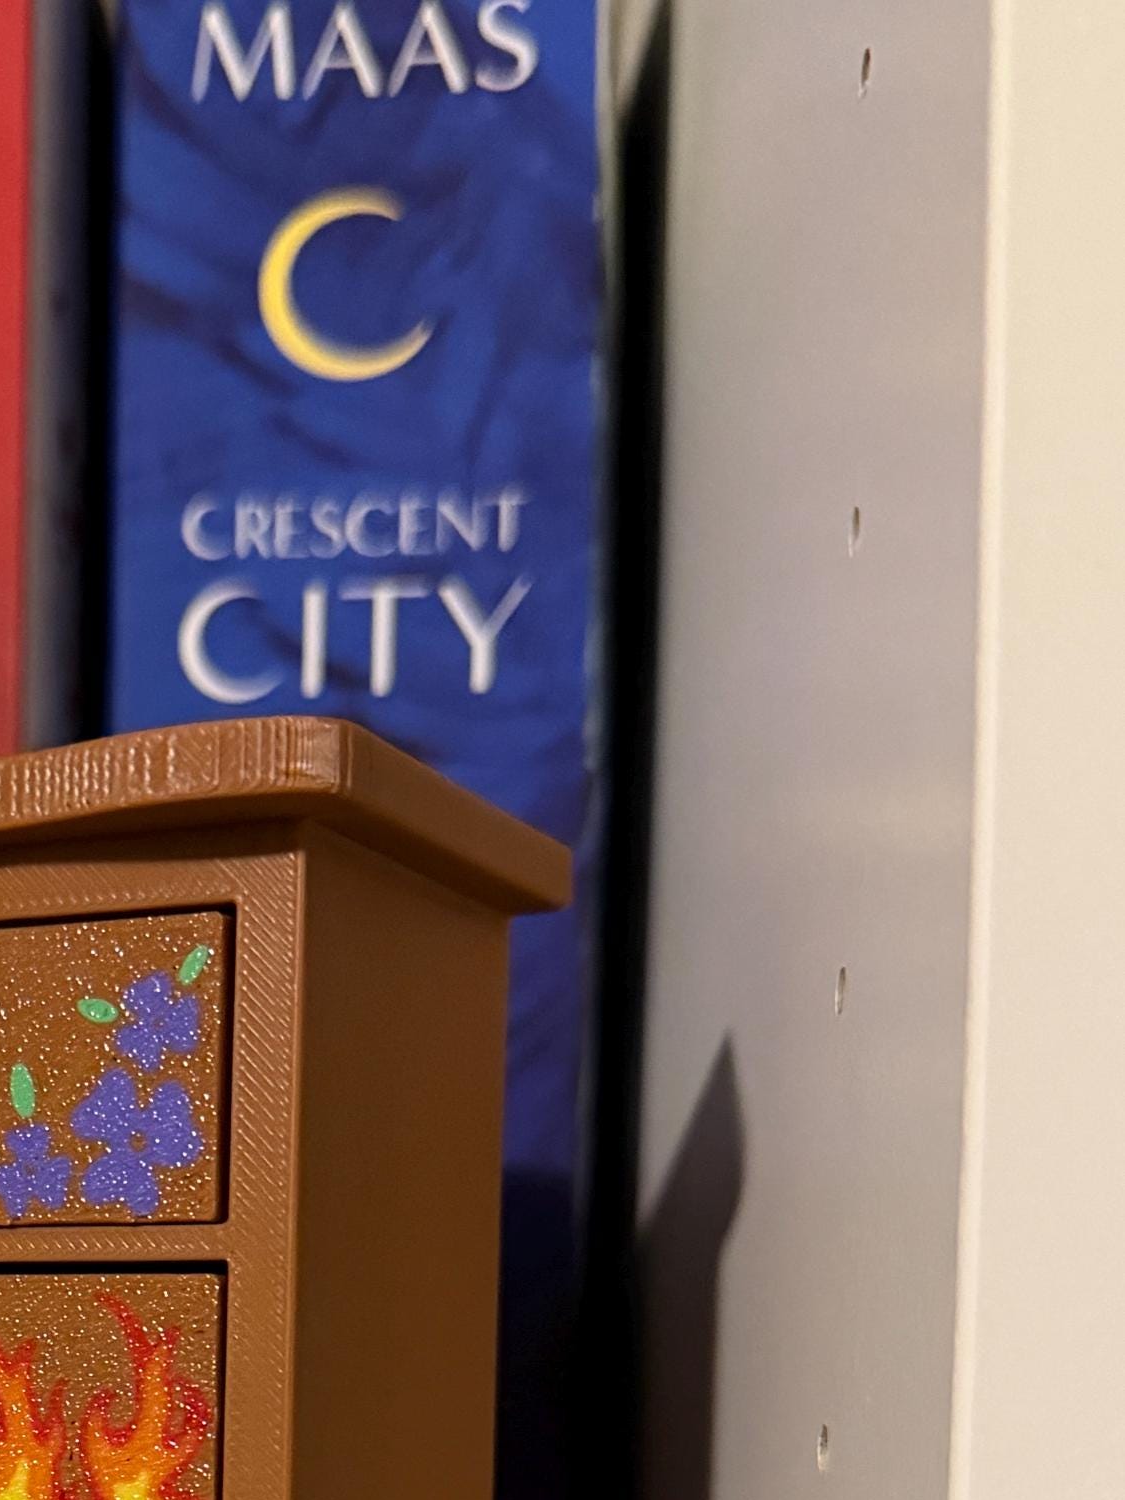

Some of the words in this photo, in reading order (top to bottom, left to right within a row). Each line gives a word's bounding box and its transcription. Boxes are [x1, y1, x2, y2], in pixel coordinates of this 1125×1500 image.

[190, 0, 539, 103] MAAS
[180, 485, 527, 561] CRESCENT
[178, 573, 533, 704] CITY
